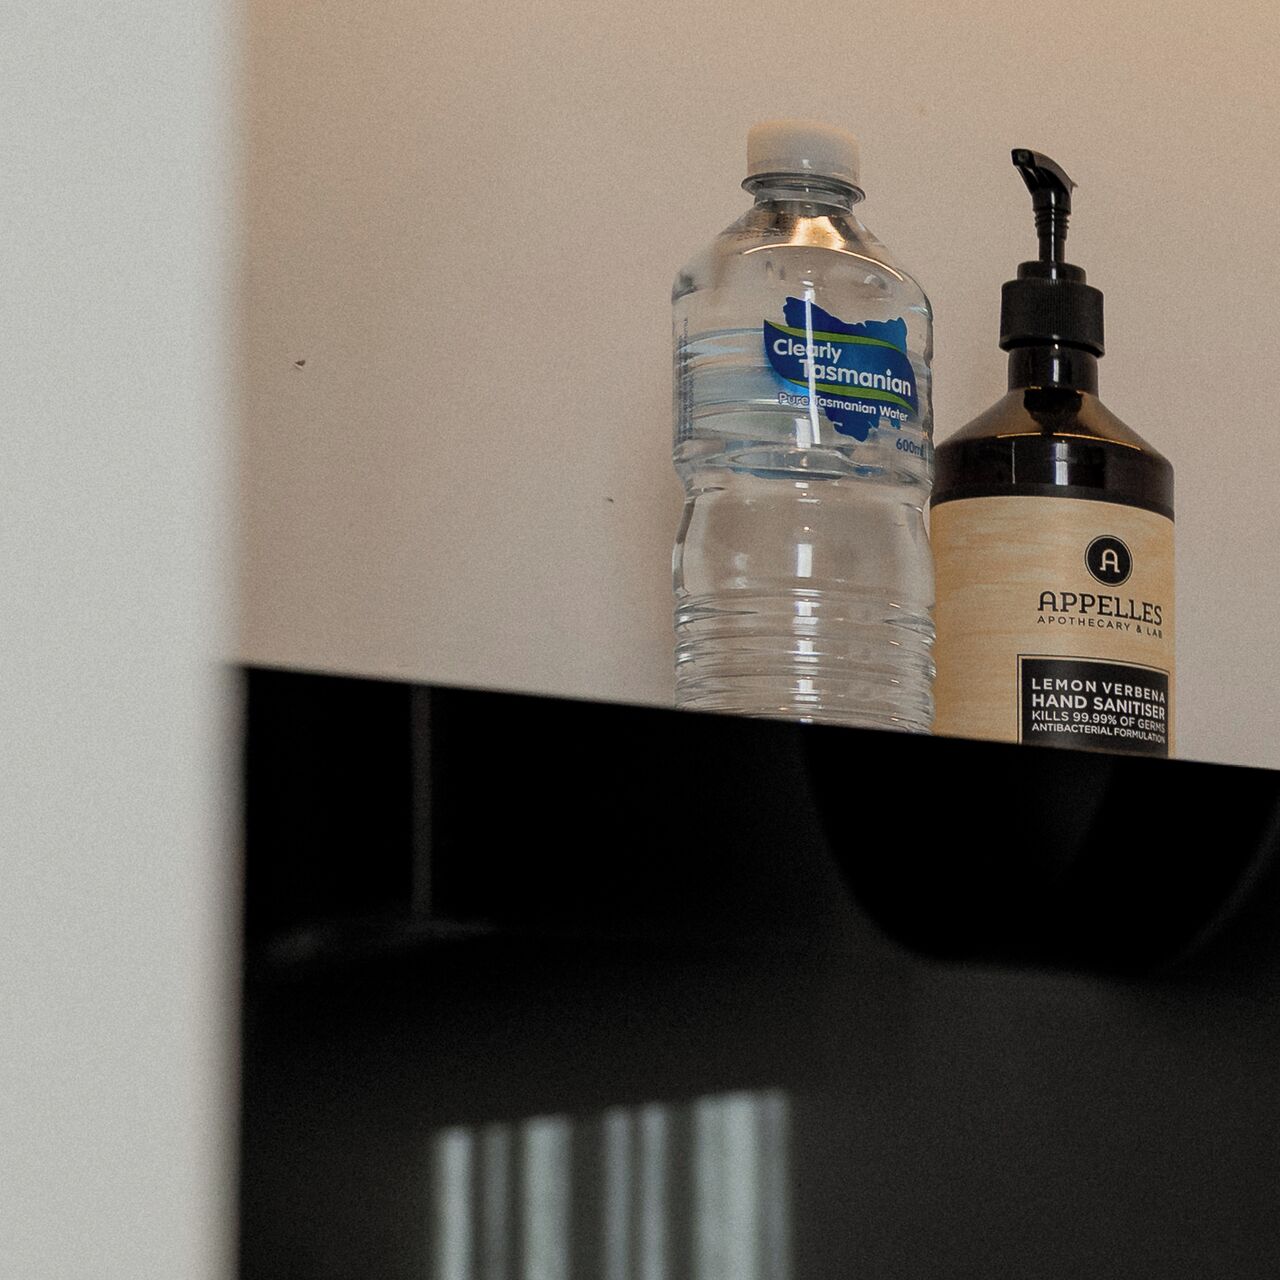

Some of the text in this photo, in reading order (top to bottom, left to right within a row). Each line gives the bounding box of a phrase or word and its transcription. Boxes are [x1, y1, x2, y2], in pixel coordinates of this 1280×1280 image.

[773, 339, 842, 364] Clearly
[799, 359, 912, 397] Tasmanian
[778, 392, 809, 405] Pure
[879, 405, 908, 423] Water
[1037, 590, 1162, 626] APPELLES
[1037, 615, 1163, 639] APOTHECARY & LAB
[1032, 678, 1166, 704] LEMON VERBENA
[1032, 694, 1166, 720] HAND SANITISER
[1032, 710, 1166, 734] KILLS 99.99% OF GERMS
[1032, 723, 1166, 744] ANTIBACTERIAL FORMULATION
